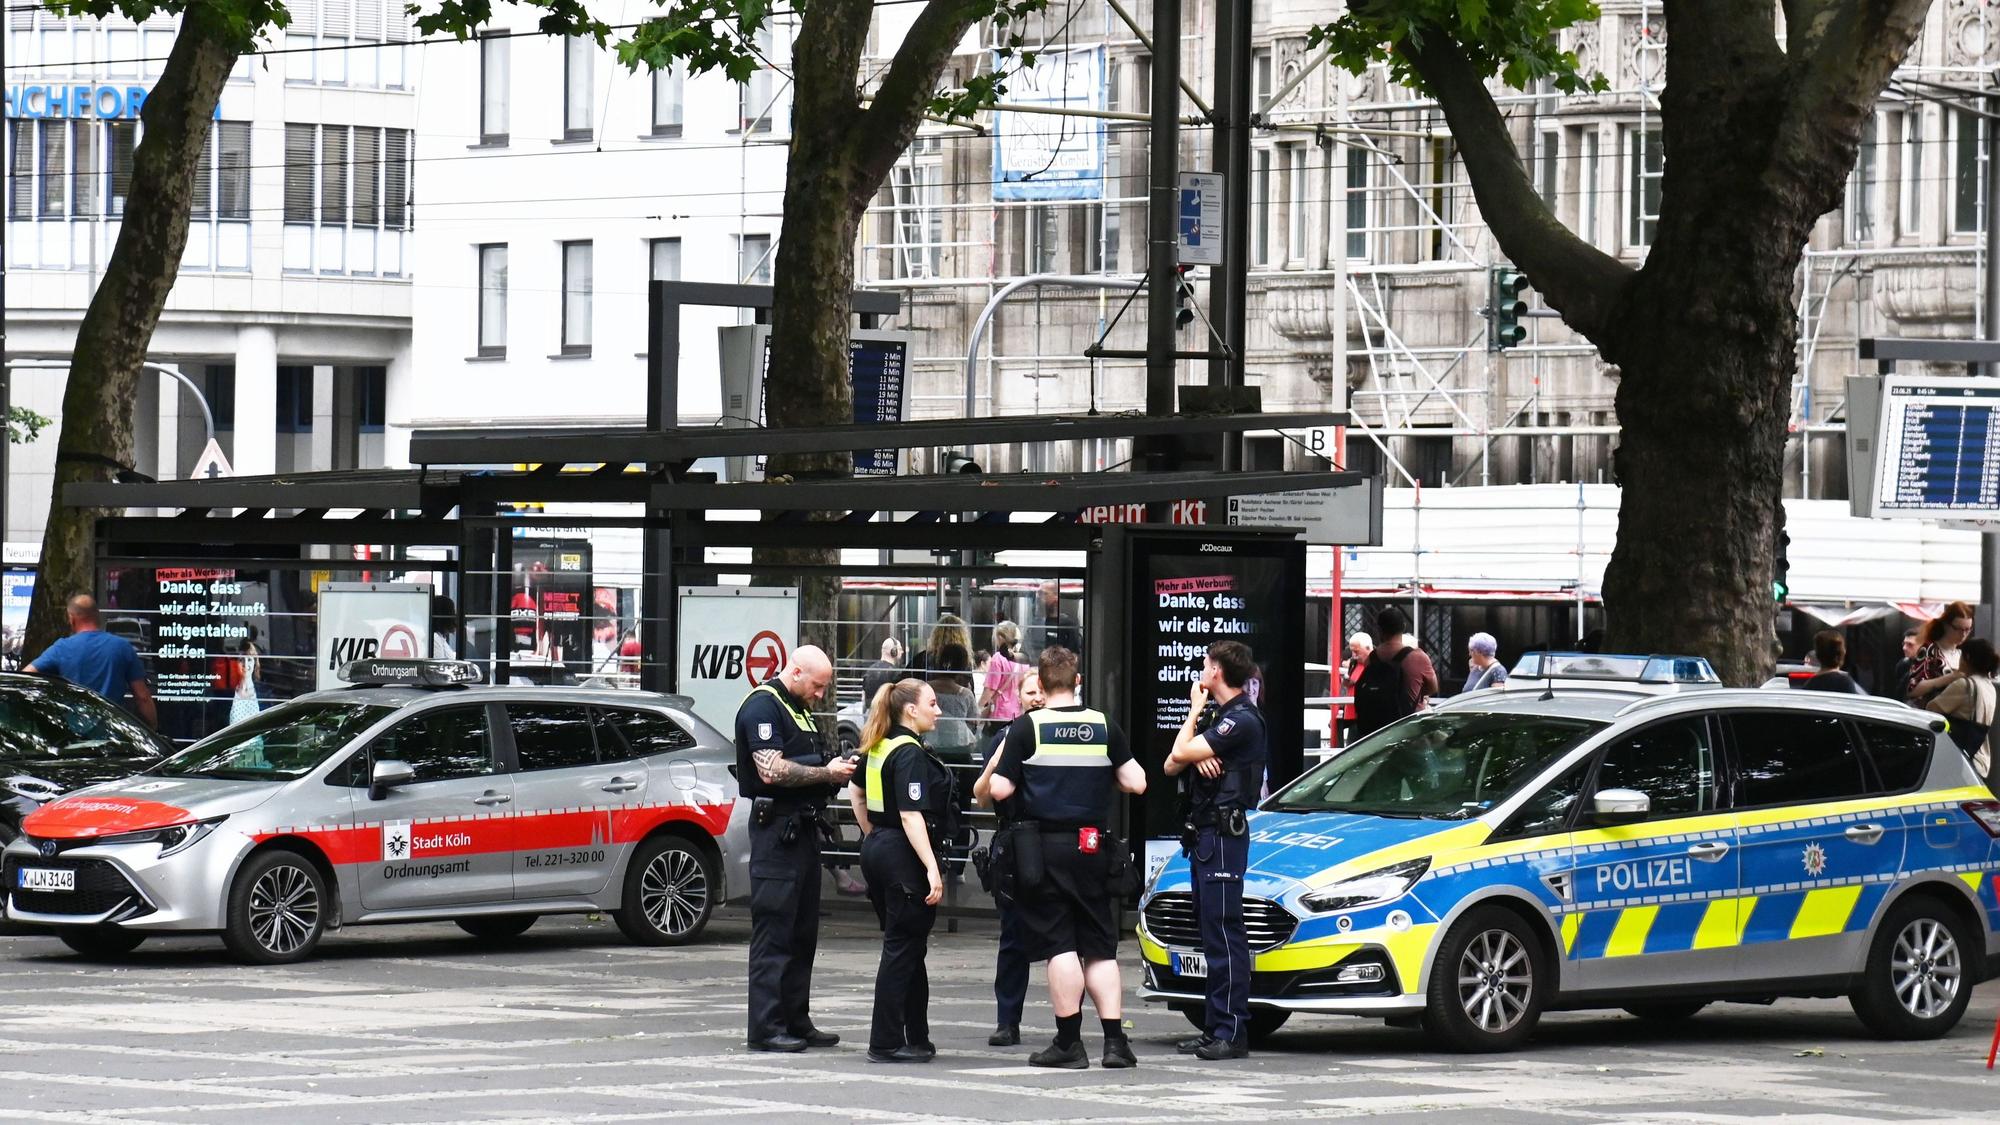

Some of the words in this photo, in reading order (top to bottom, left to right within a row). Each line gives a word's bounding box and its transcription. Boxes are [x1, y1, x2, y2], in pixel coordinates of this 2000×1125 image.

[1312, 430, 1325, 450] B
[6, 547, 39, 558] Neuma
[1200, 544, 1233, 552] JCDecaux
[158, 571, 178, 579] Mehr
[181, 570, 192, 578] als
[160, 580, 207, 595] Danke,
[210, 580, 241, 594] dass
[1157, 580, 1179, 592] Mehr
[1181, 580, 1193, 590] als
[160, 600, 183, 615] wir
[186, 601, 206, 615] die
[210, 602, 266, 616] Zukunft
[1159, 593, 1210, 610] Danke,
[1213, 593, 1246, 609] dass
[159, 622, 248, 640] mitgestalten
[1158, 616, 1184, 633] wir
[1187, 617, 1210, 633] die
[159, 644, 206, 659] dürfen
[329, 638, 379, 670] KVB
[1158, 640, 1208, 661] mitges
[691, 645, 744, 679] KVB
[372, 664, 418, 679] Ordnungsamt
[1157, 714, 1180, 722] Hamburg
[1055, 728, 1077, 738] KVB
[413, 835, 443, 849] Stadt
[446, 833, 471, 847] Köln
[525, 855, 542, 868] Tel.
[591, 850, 605, 862] 00
[384, 859, 470, 880] Ordnungsamt
[1596, 858, 1692, 892] POLIZEI
[23, 872, 28, 885] K
[34, 872, 47, 886] LN
[49, 872, 73, 887] 3148
[1178, 956, 1200, 974] NRW
